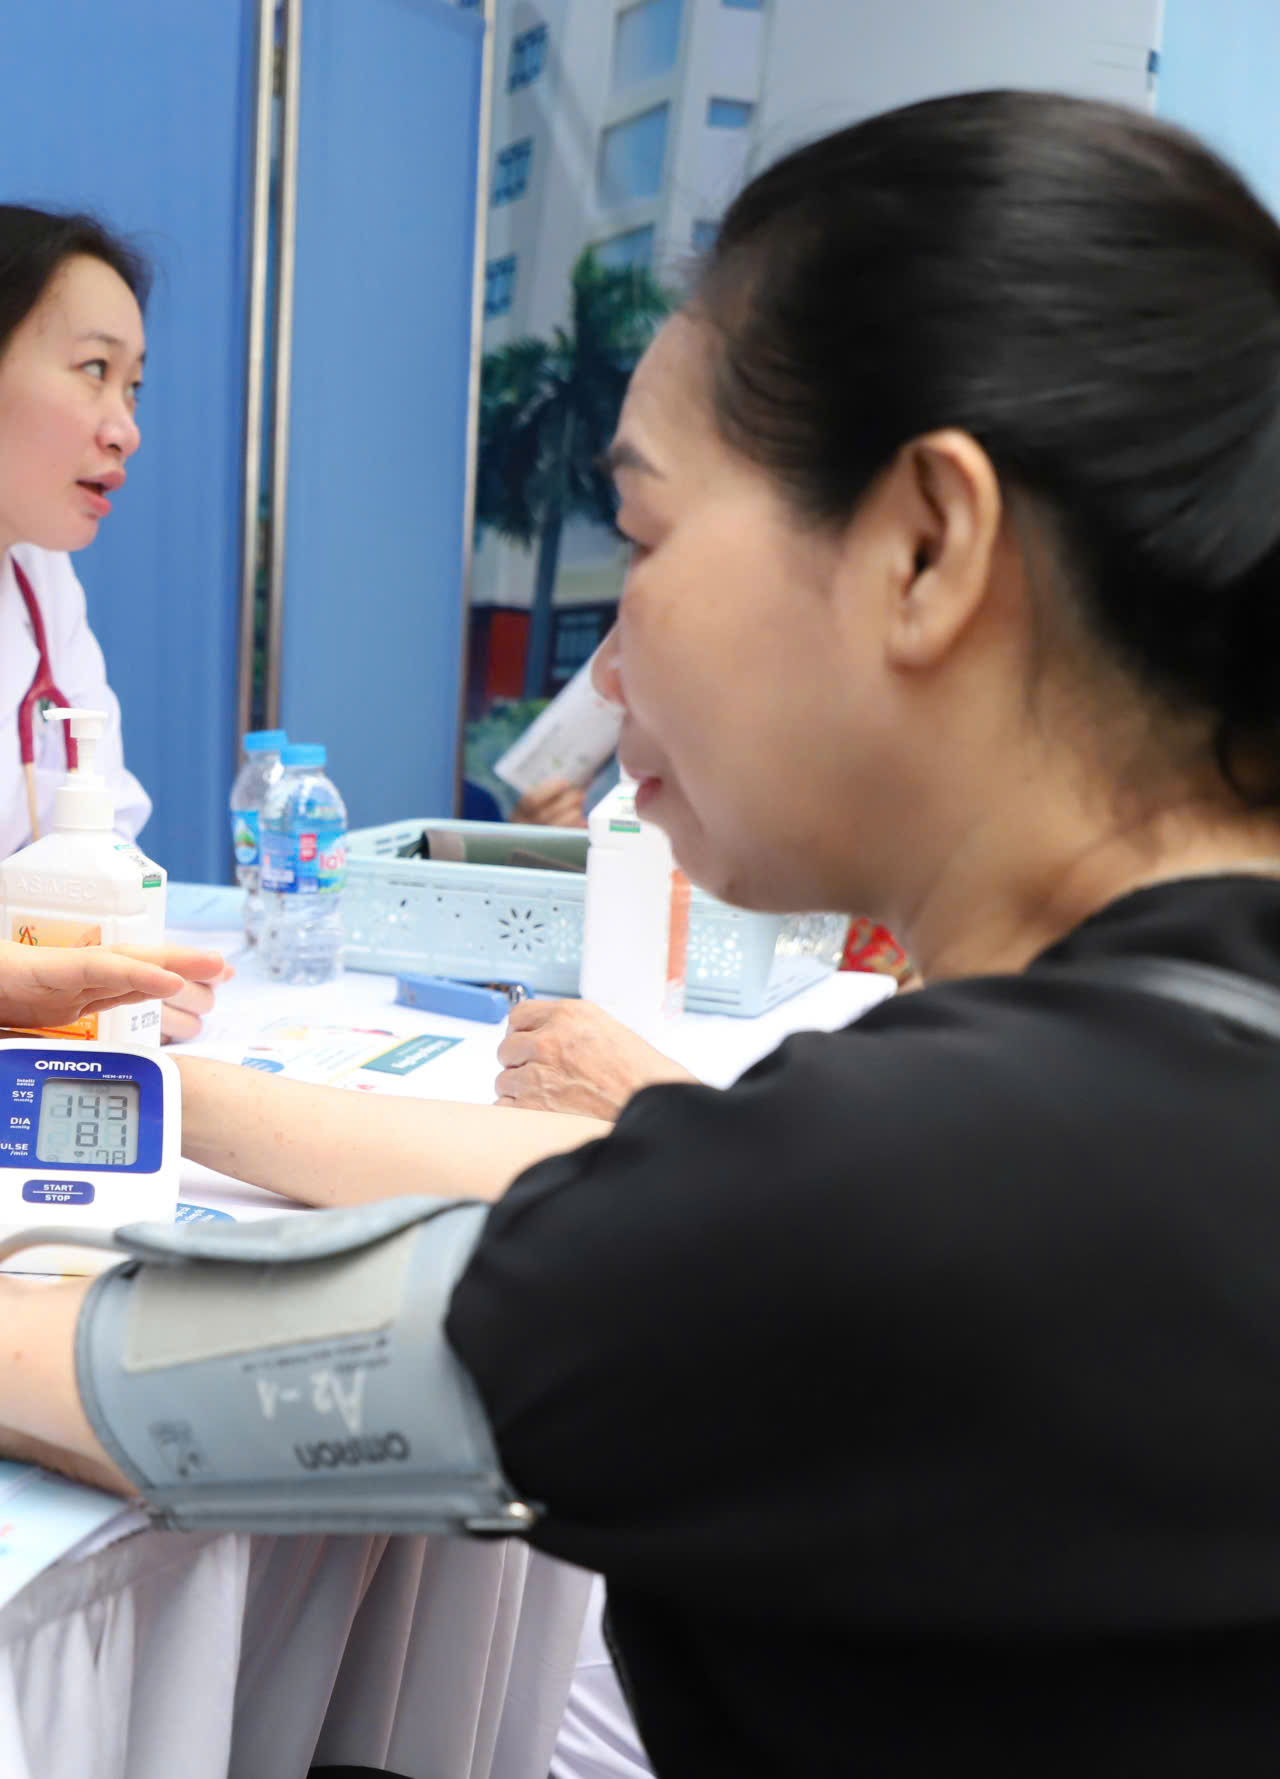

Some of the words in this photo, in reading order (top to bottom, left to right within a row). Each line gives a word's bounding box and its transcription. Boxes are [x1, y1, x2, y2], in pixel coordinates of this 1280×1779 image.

[12, 1090, 34, 1098] SYS
[66, 1095, 128, 1121] 143
[10, 1117, 31, 1125] DIA
[75, 1122, 127, 1147] 81
